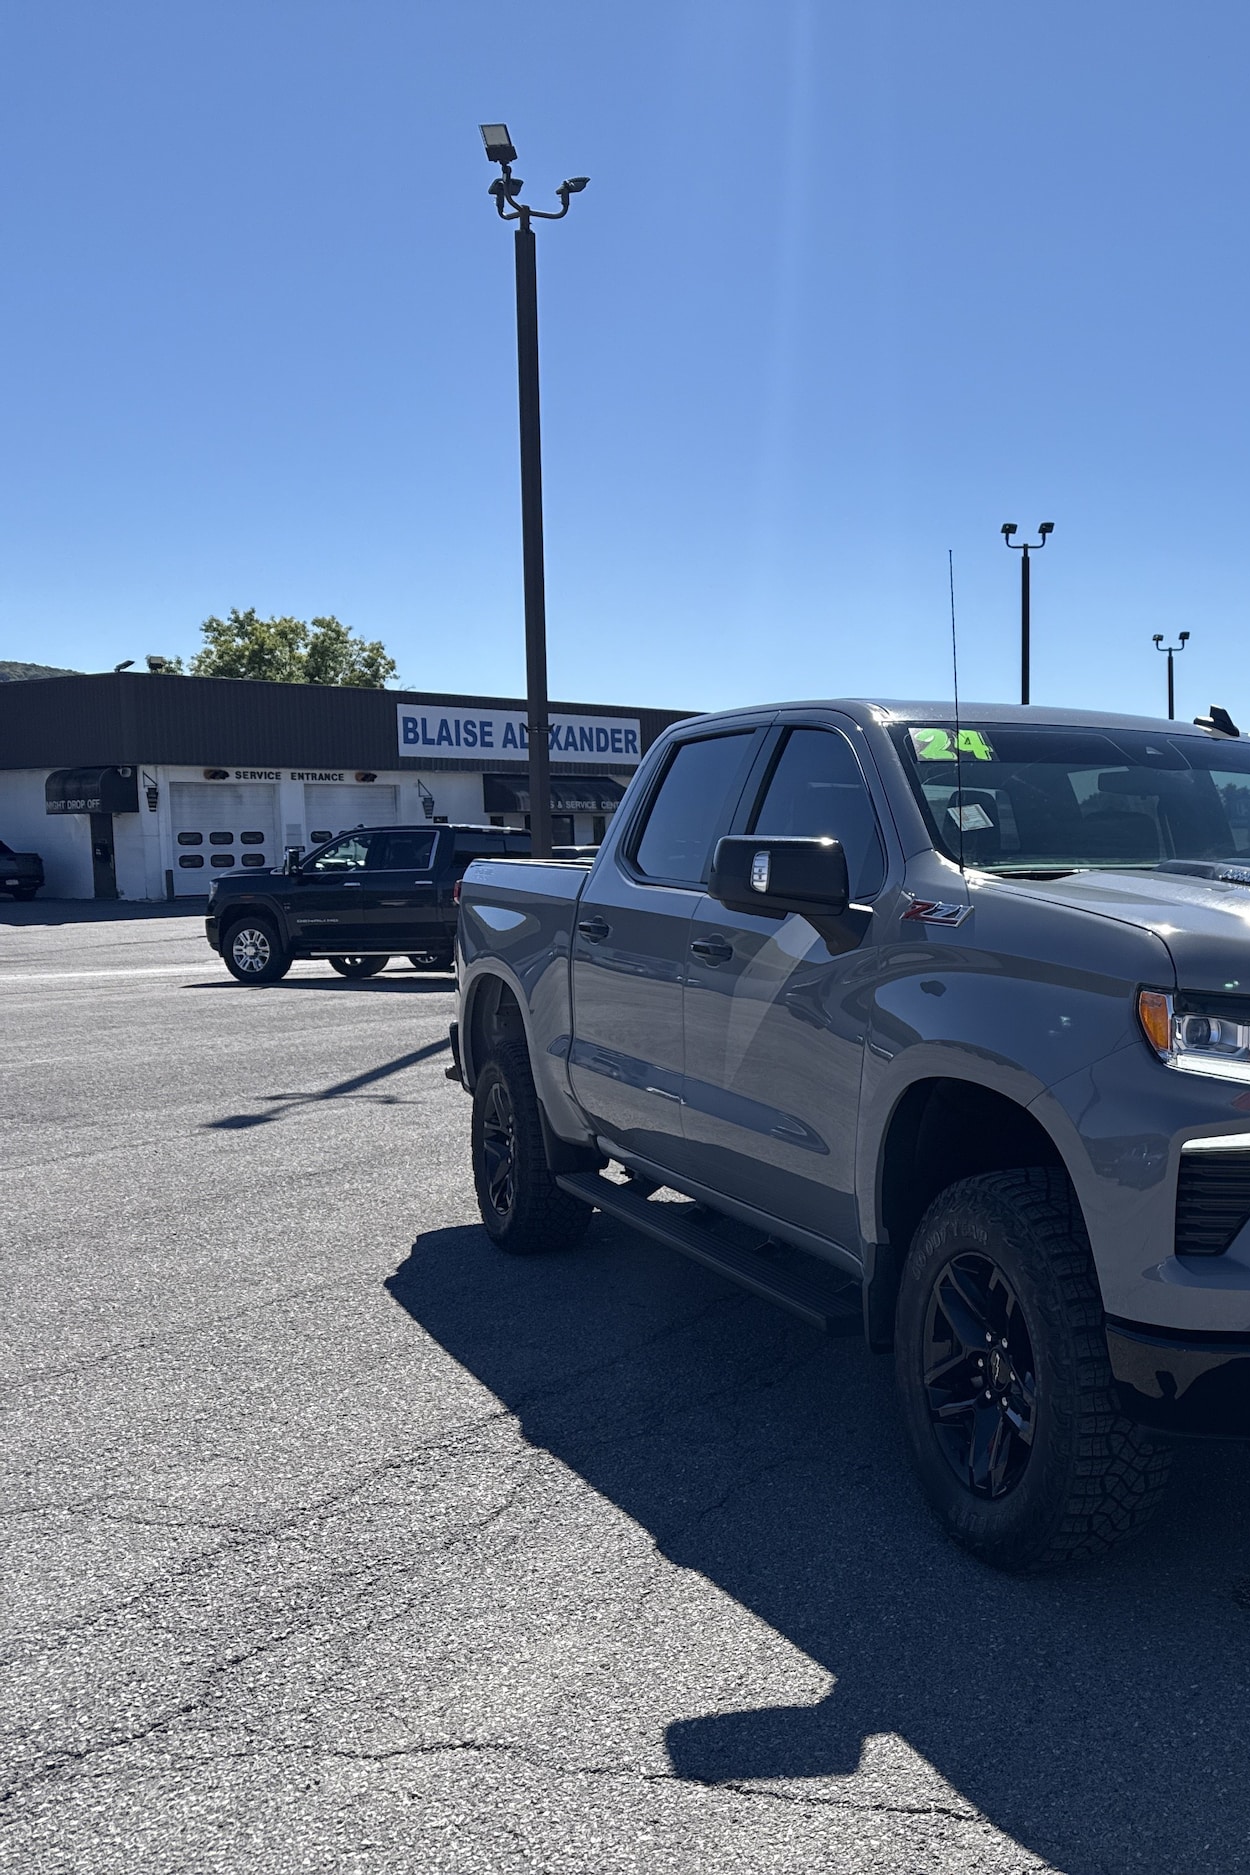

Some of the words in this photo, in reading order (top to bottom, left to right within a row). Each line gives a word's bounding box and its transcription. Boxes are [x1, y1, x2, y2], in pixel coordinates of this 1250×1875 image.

[402, 716, 495, 748] BLAISE
[502, 722, 639, 754] ALXANDER
[914, 728, 993, 761] 24
[235, 770, 282, 780] SERVICE
[290, 772, 345, 781] ENTRANCE
[46, 800, 66, 810] NIGHT
[67, 799, 86, 809] DROP
[87, 799, 100, 808] OFF
[558, 801, 563, 809] &
[566, 801, 597, 809] SERVICE
[601, 801, 620, 809] CENT
[899, 892, 975, 928] Z71
